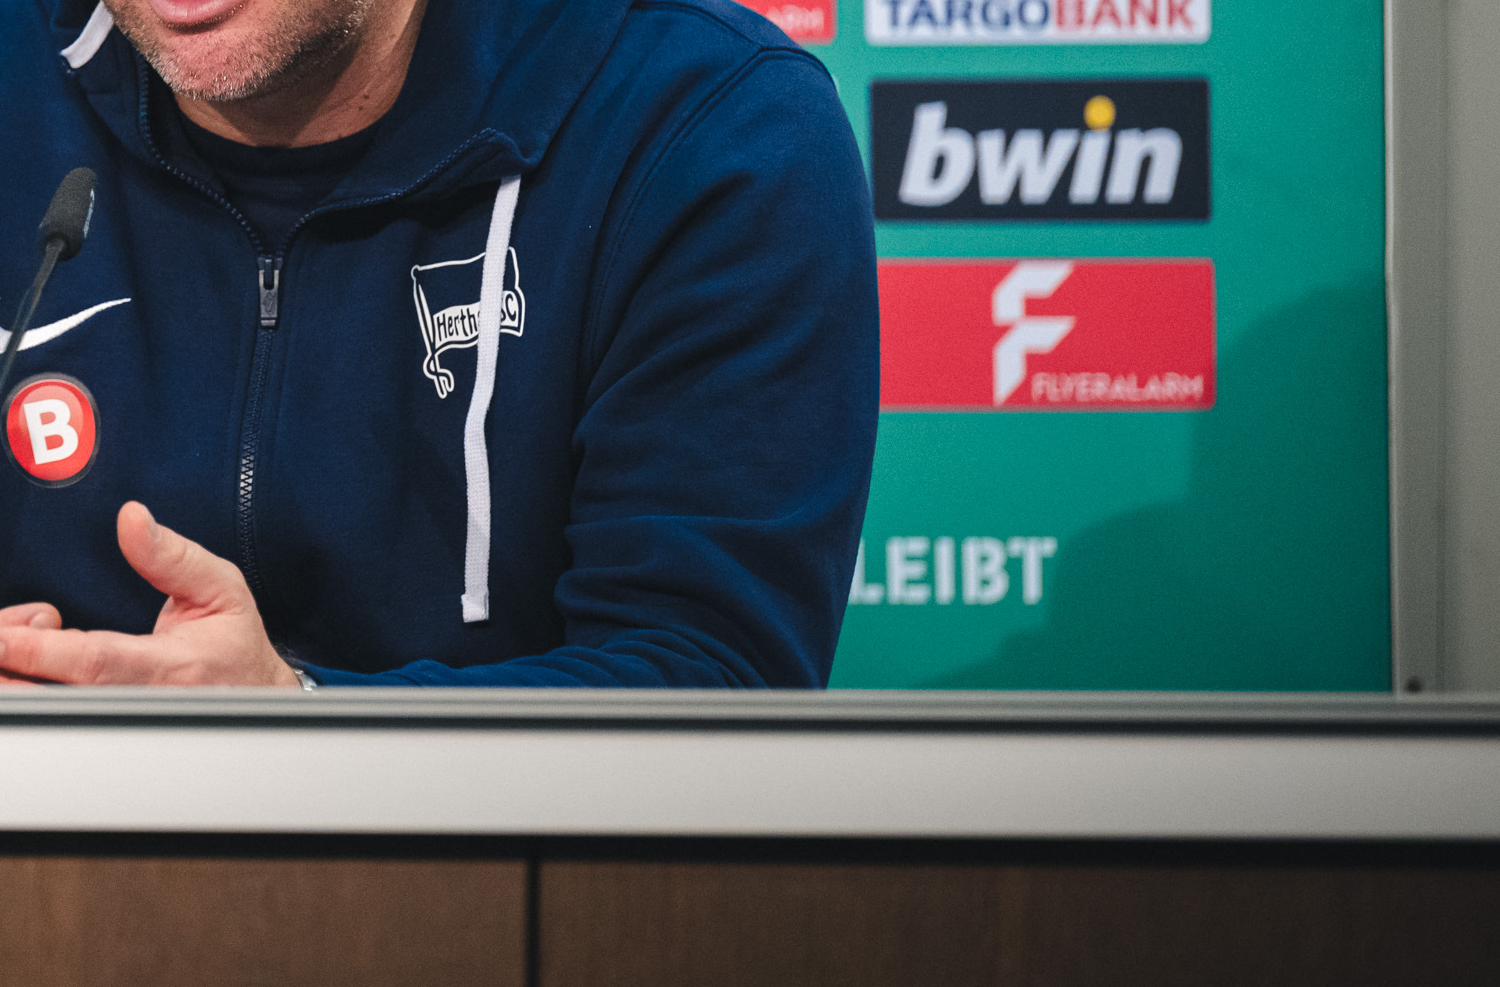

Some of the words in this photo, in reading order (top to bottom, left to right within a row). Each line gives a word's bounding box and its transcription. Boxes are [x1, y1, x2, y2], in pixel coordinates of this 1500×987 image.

[899, 97, 1181, 206] bwin
[436, 307, 480, 341] Herth
[501, 293, 518, 322] C
[24, 399, 78, 465] B
